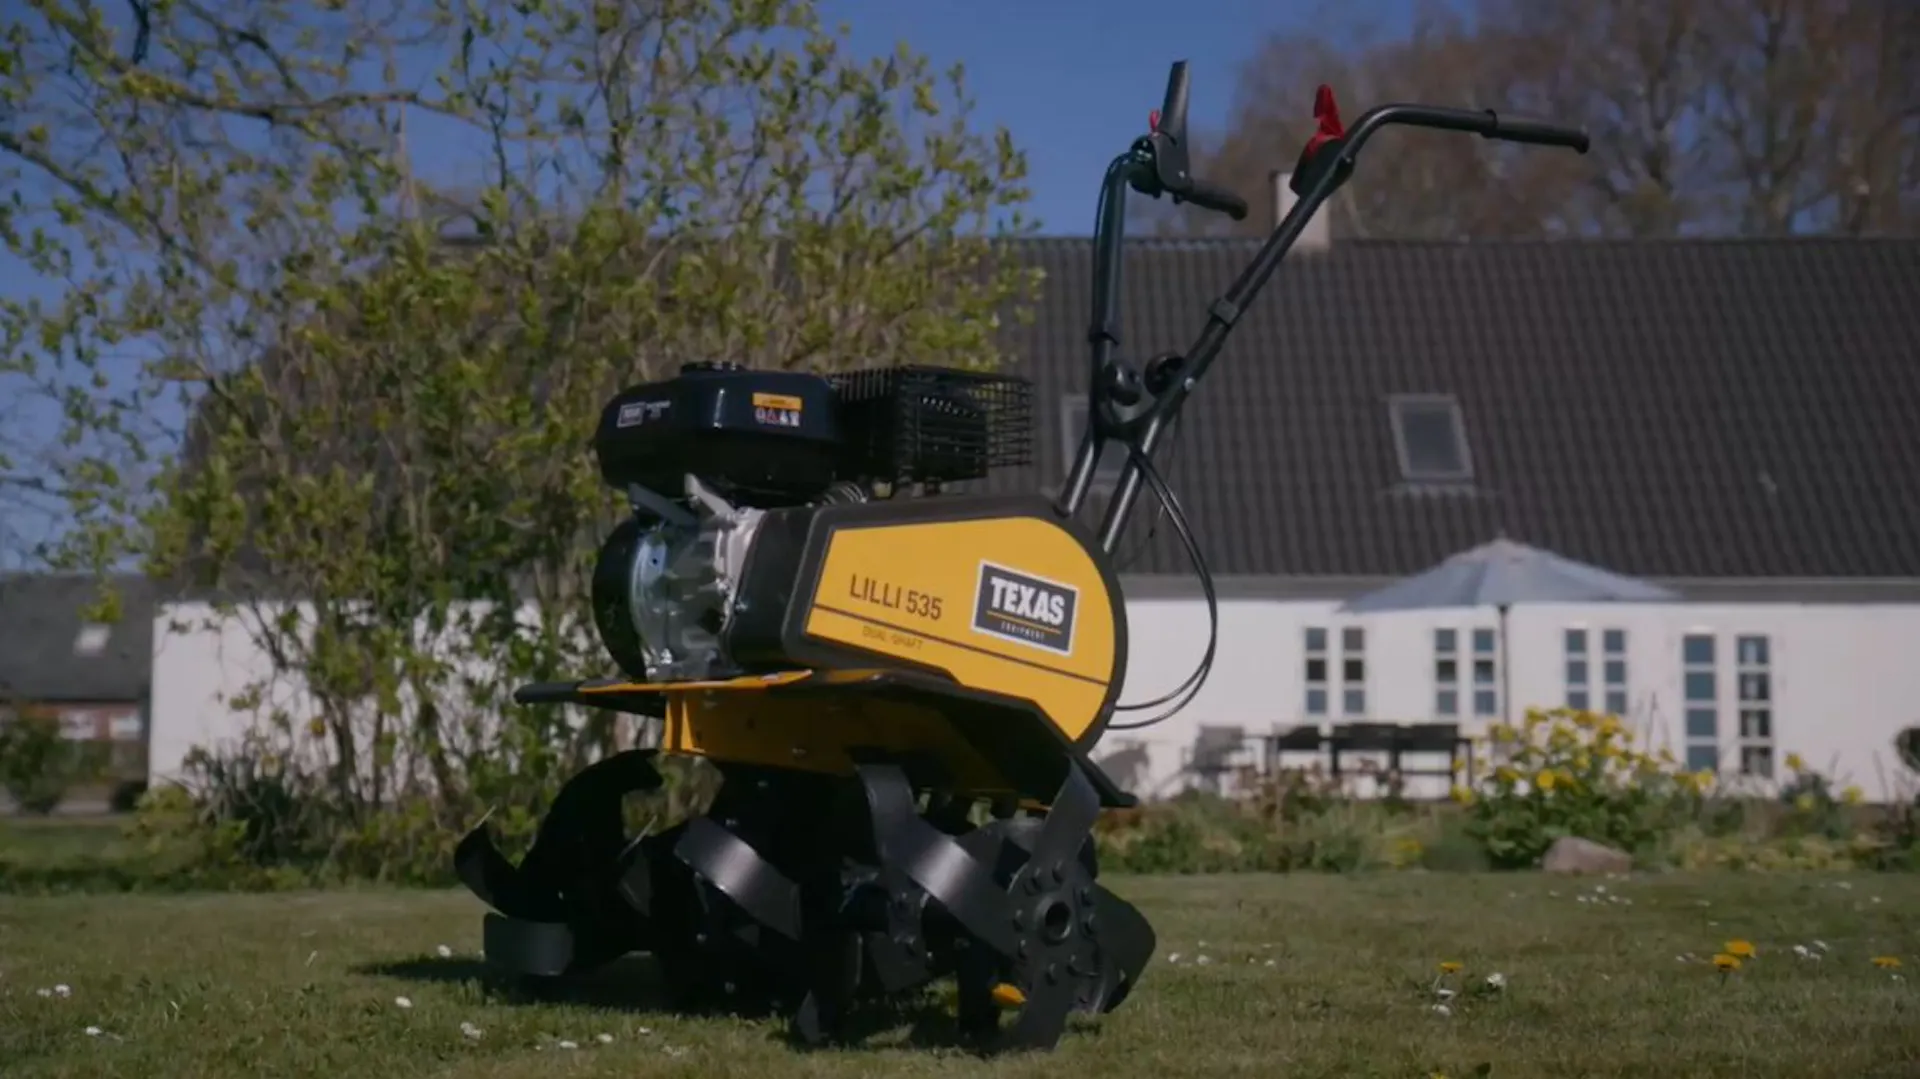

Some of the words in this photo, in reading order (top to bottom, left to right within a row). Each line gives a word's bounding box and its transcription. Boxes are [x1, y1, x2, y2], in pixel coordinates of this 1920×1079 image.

[849, 573, 902, 609] LILLI
[905, 590, 944, 621] 535
[989, 577, 1066, 626] TEXAS
